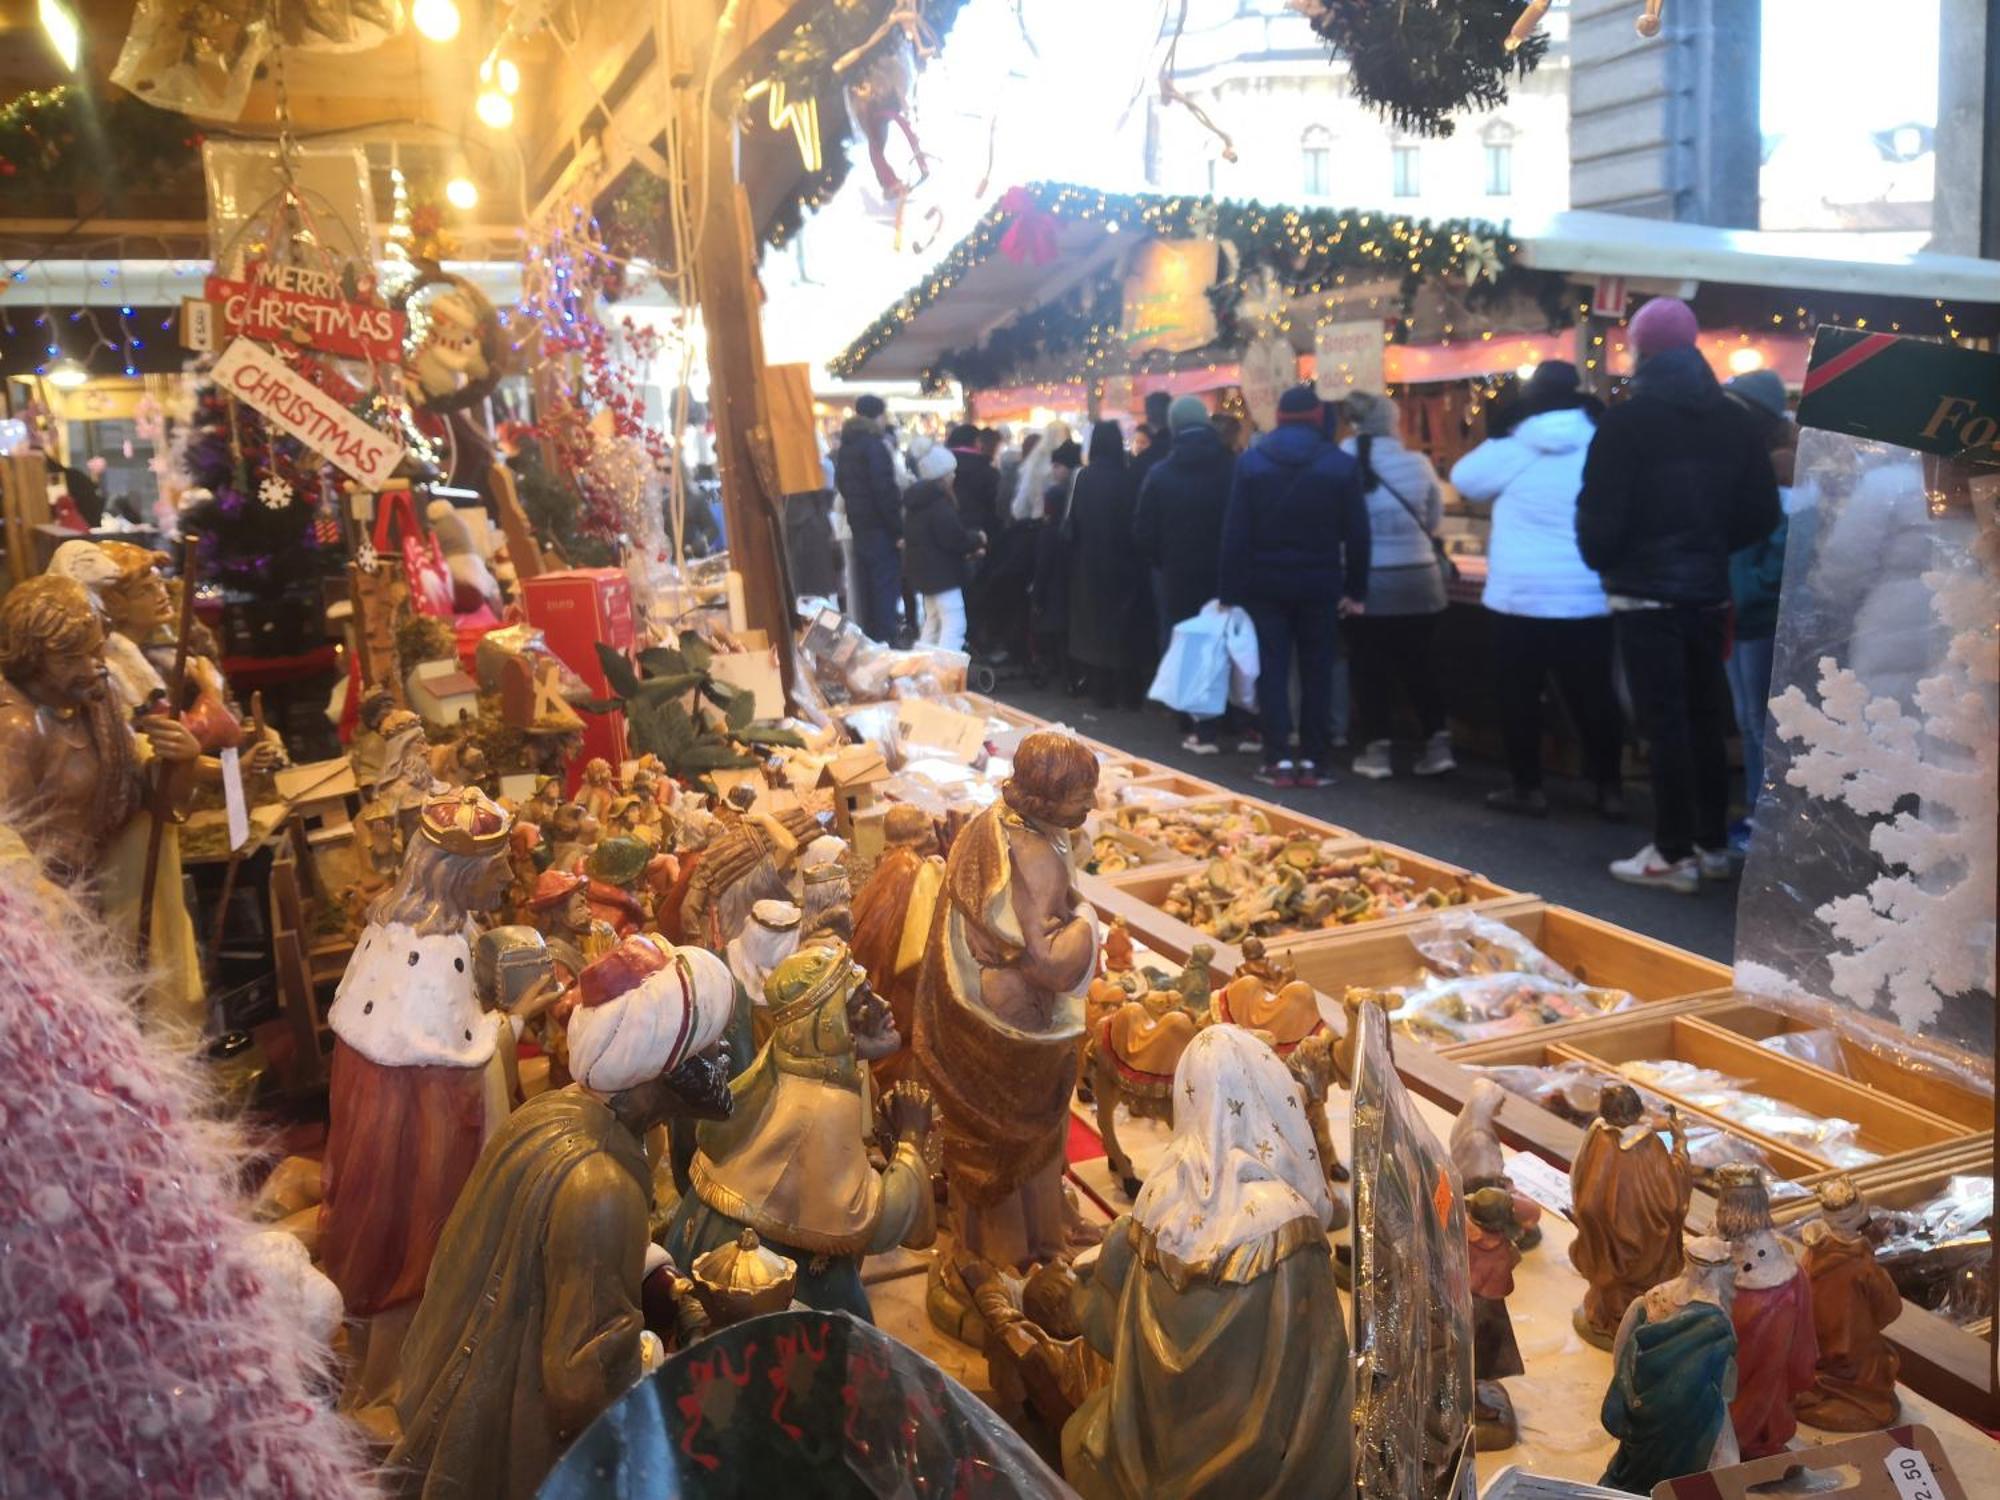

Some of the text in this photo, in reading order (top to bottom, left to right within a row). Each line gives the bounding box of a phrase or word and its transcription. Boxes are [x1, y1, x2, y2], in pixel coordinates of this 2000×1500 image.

[259, 264, 342, 299] MERRY
[224, 294, 393, 341] CHRISTMAS
[233, 364, 383, 474] CHRISTMAS
[1900, 1458, 1932, 1500] 2.50
